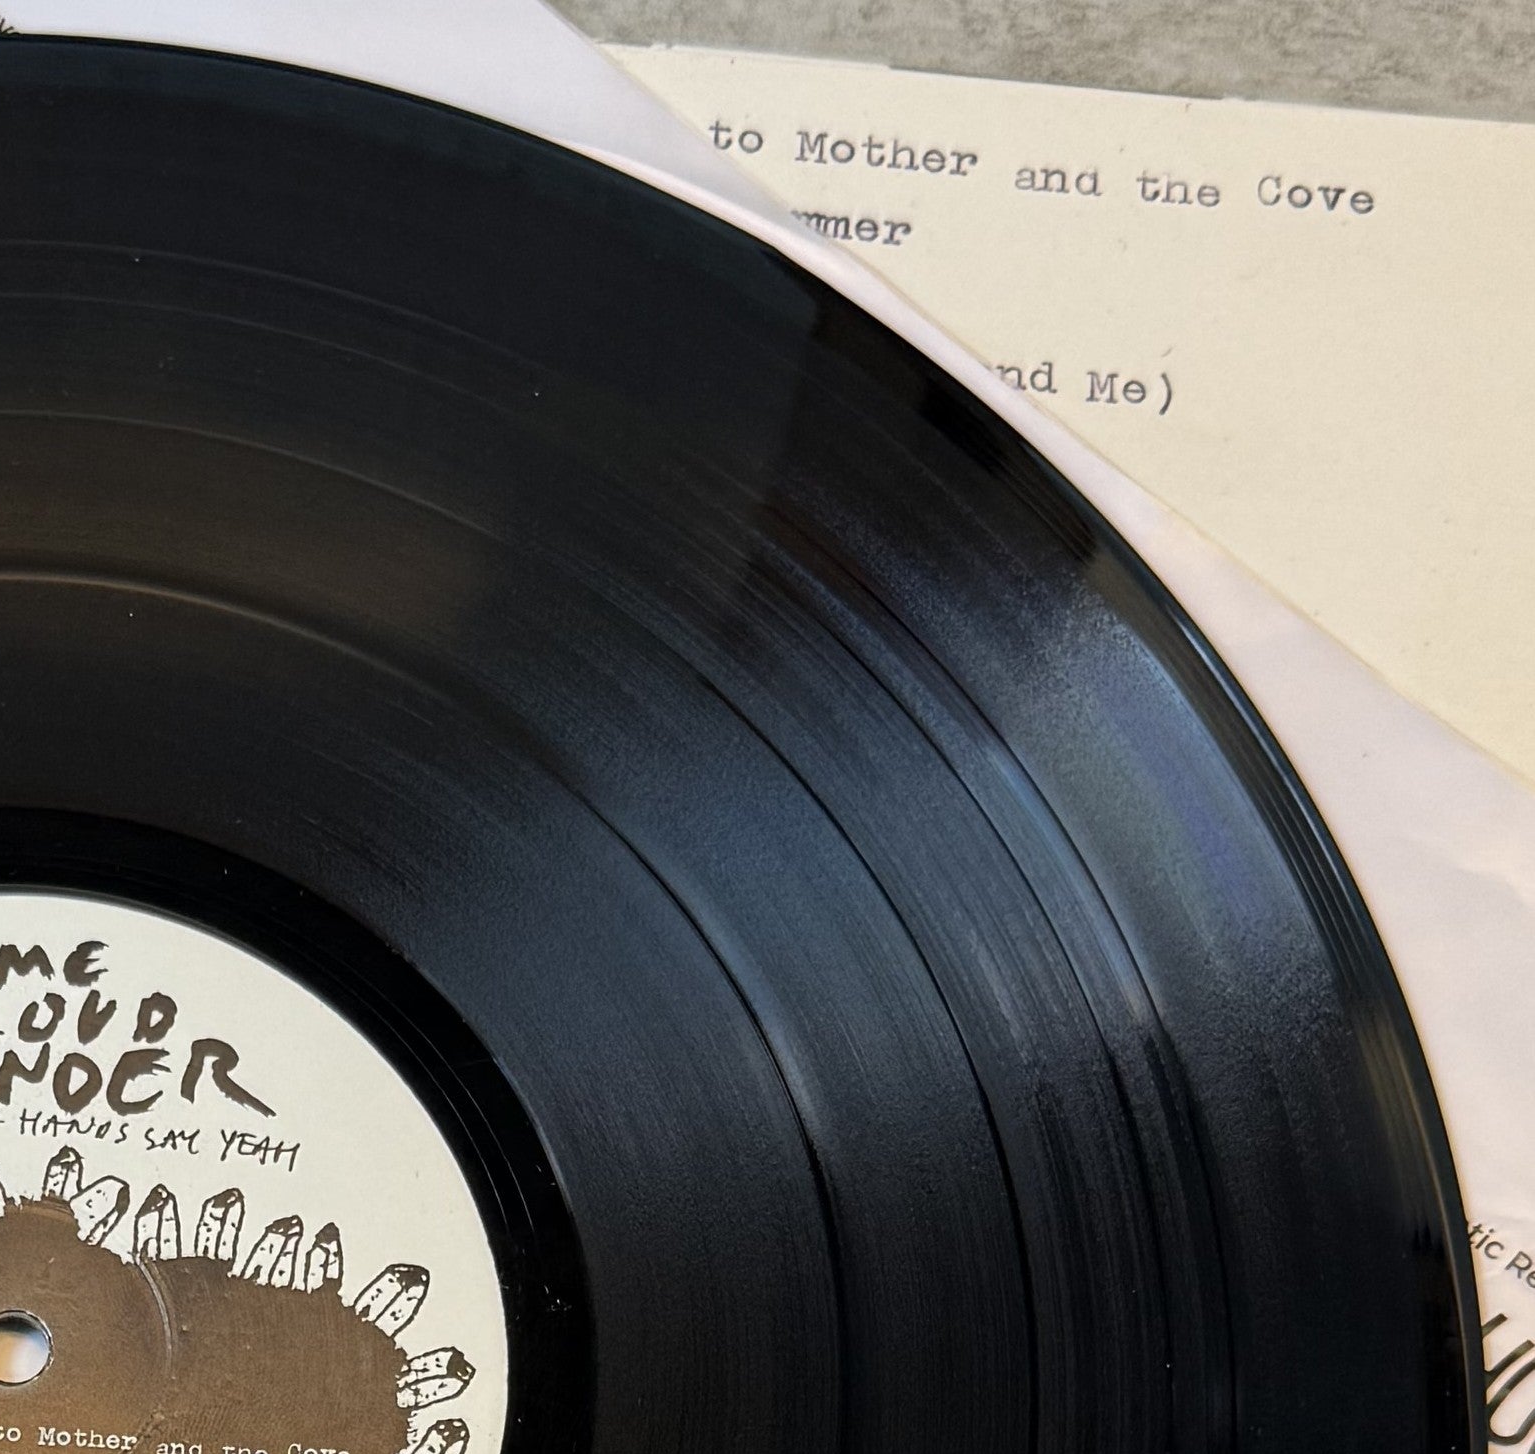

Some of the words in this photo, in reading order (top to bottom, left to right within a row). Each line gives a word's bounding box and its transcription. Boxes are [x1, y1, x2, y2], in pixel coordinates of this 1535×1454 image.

[708, 120, 764, 155] to
[794, 130, 979, 177] Mother
[1014, 166, 1102, 198] and
[1136, 169, 1222, 208] the
[1256, 174, 1376, 216] Cove
[1084, 370, 1173, 416] Me)
[19, 1108, 129, 1144] HANDS
[145, 1128, 200, 1155] SAY
[220, 1129, 301, 1172] YEAH
[38, 1426, 138, 1452] Mother
